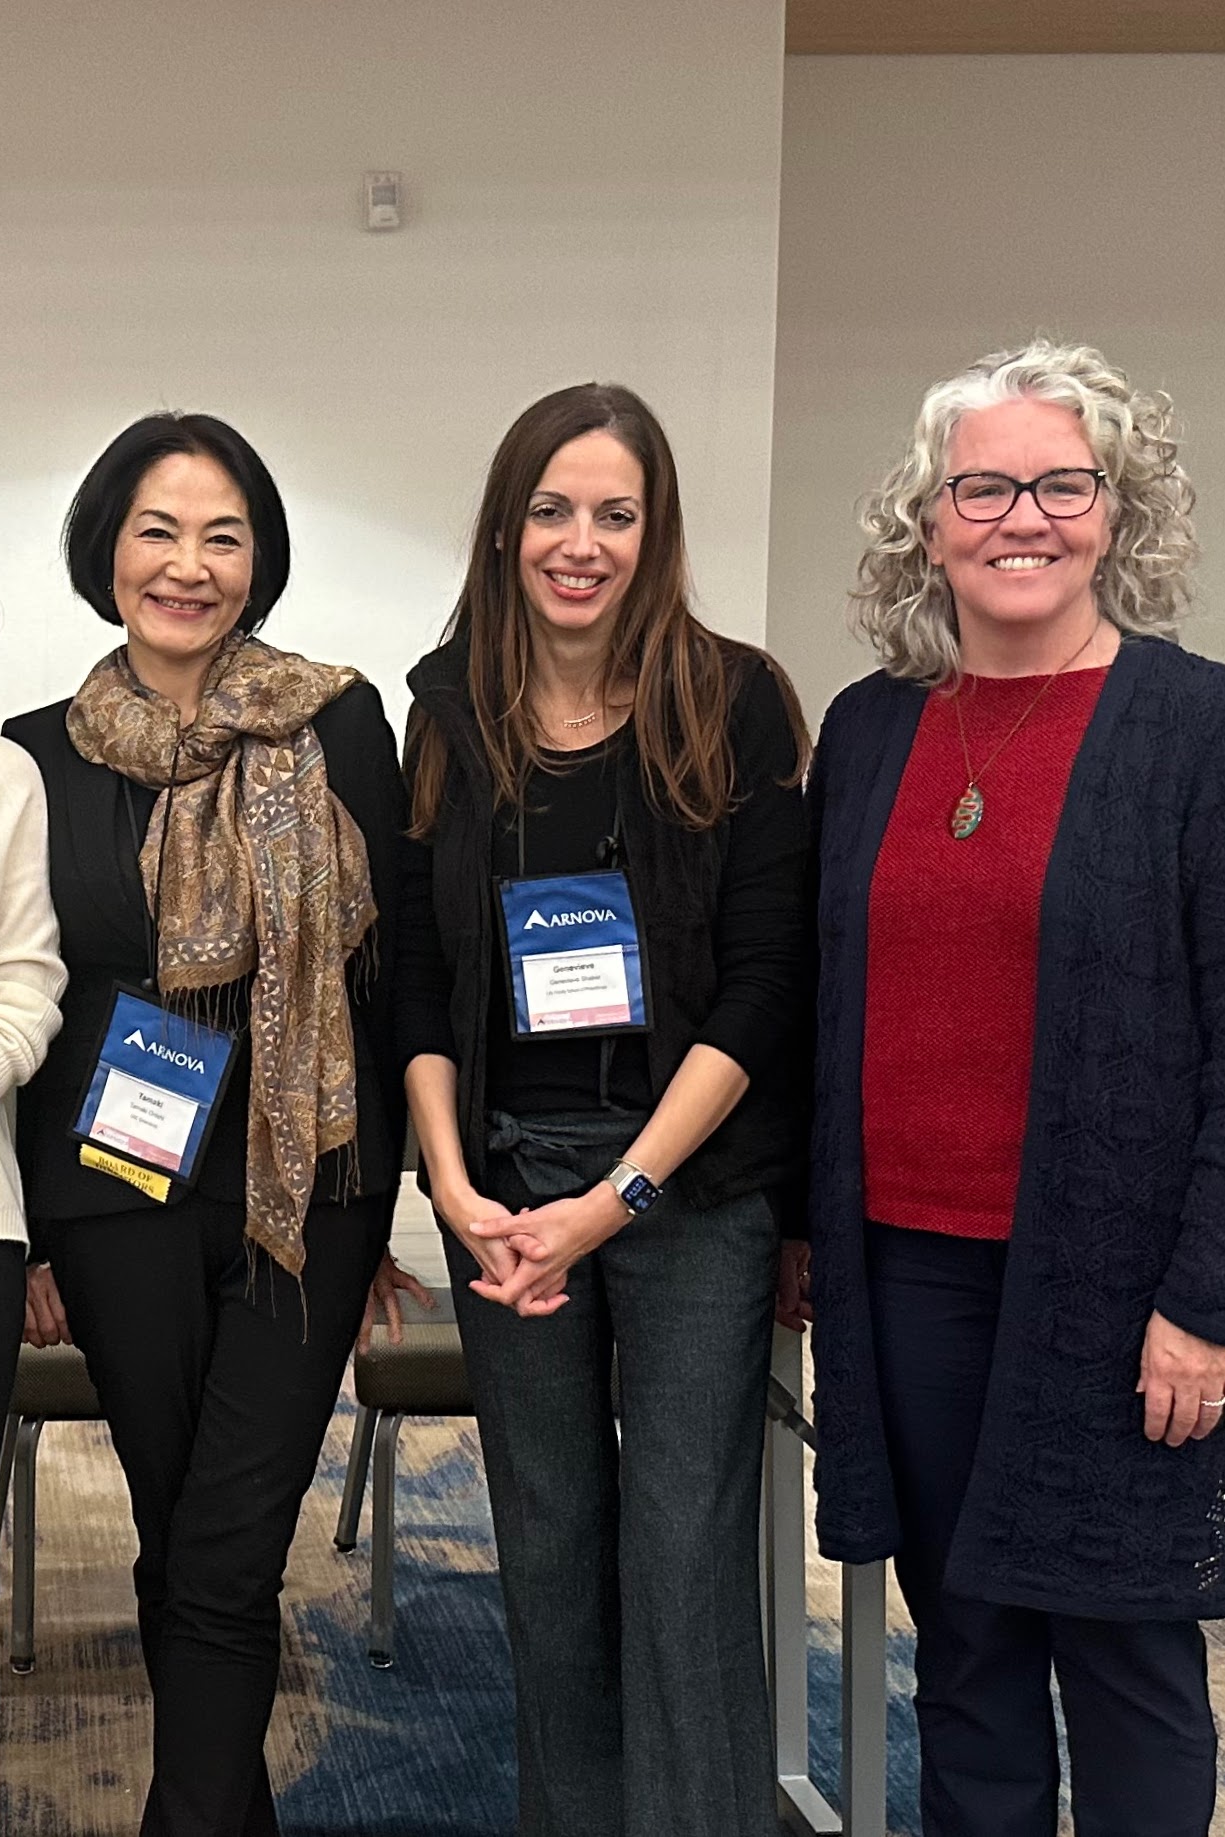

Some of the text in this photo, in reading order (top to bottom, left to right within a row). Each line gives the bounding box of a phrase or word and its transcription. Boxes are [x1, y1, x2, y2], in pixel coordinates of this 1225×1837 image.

[550, 909, 617, 927] ARNOVA
[146, 1041, 205, 1074] ARNOVA
[138, 1092, 164, 1108] Tamaki
[97, 1156, 136, 1178] BOARD
[137, 1171, 154, 1182] OF
